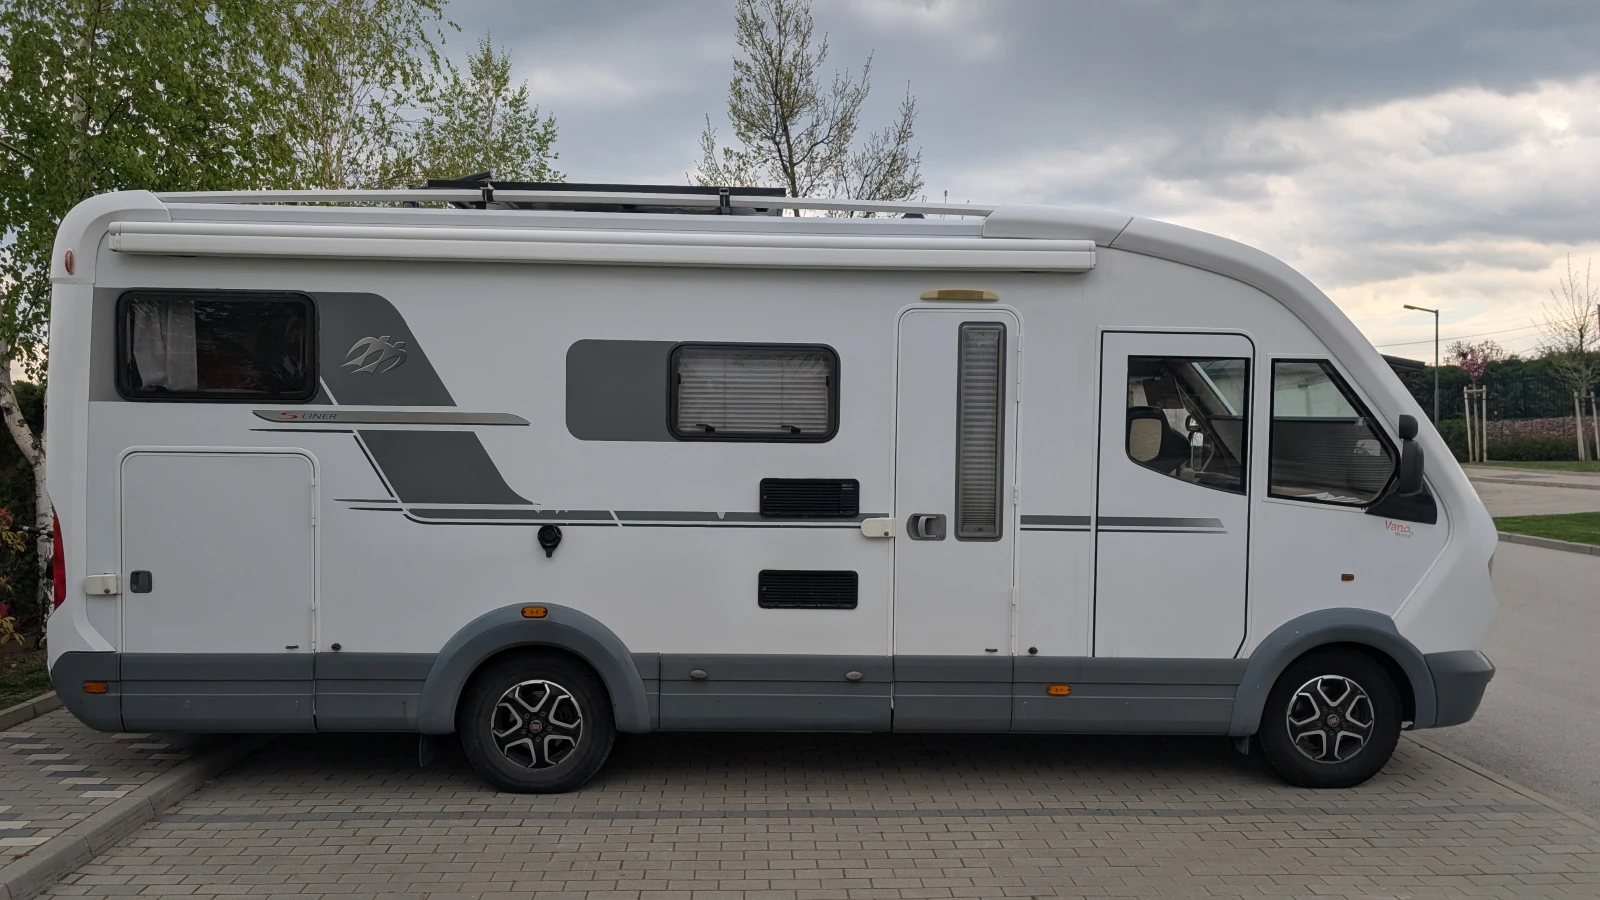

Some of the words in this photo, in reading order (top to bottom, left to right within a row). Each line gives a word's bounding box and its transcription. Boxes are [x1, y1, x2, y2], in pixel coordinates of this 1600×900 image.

[280, 411, 298, 420] S
[301, 412, 338, 420] LINER
[1384, 520, 1411, 532] Vano
